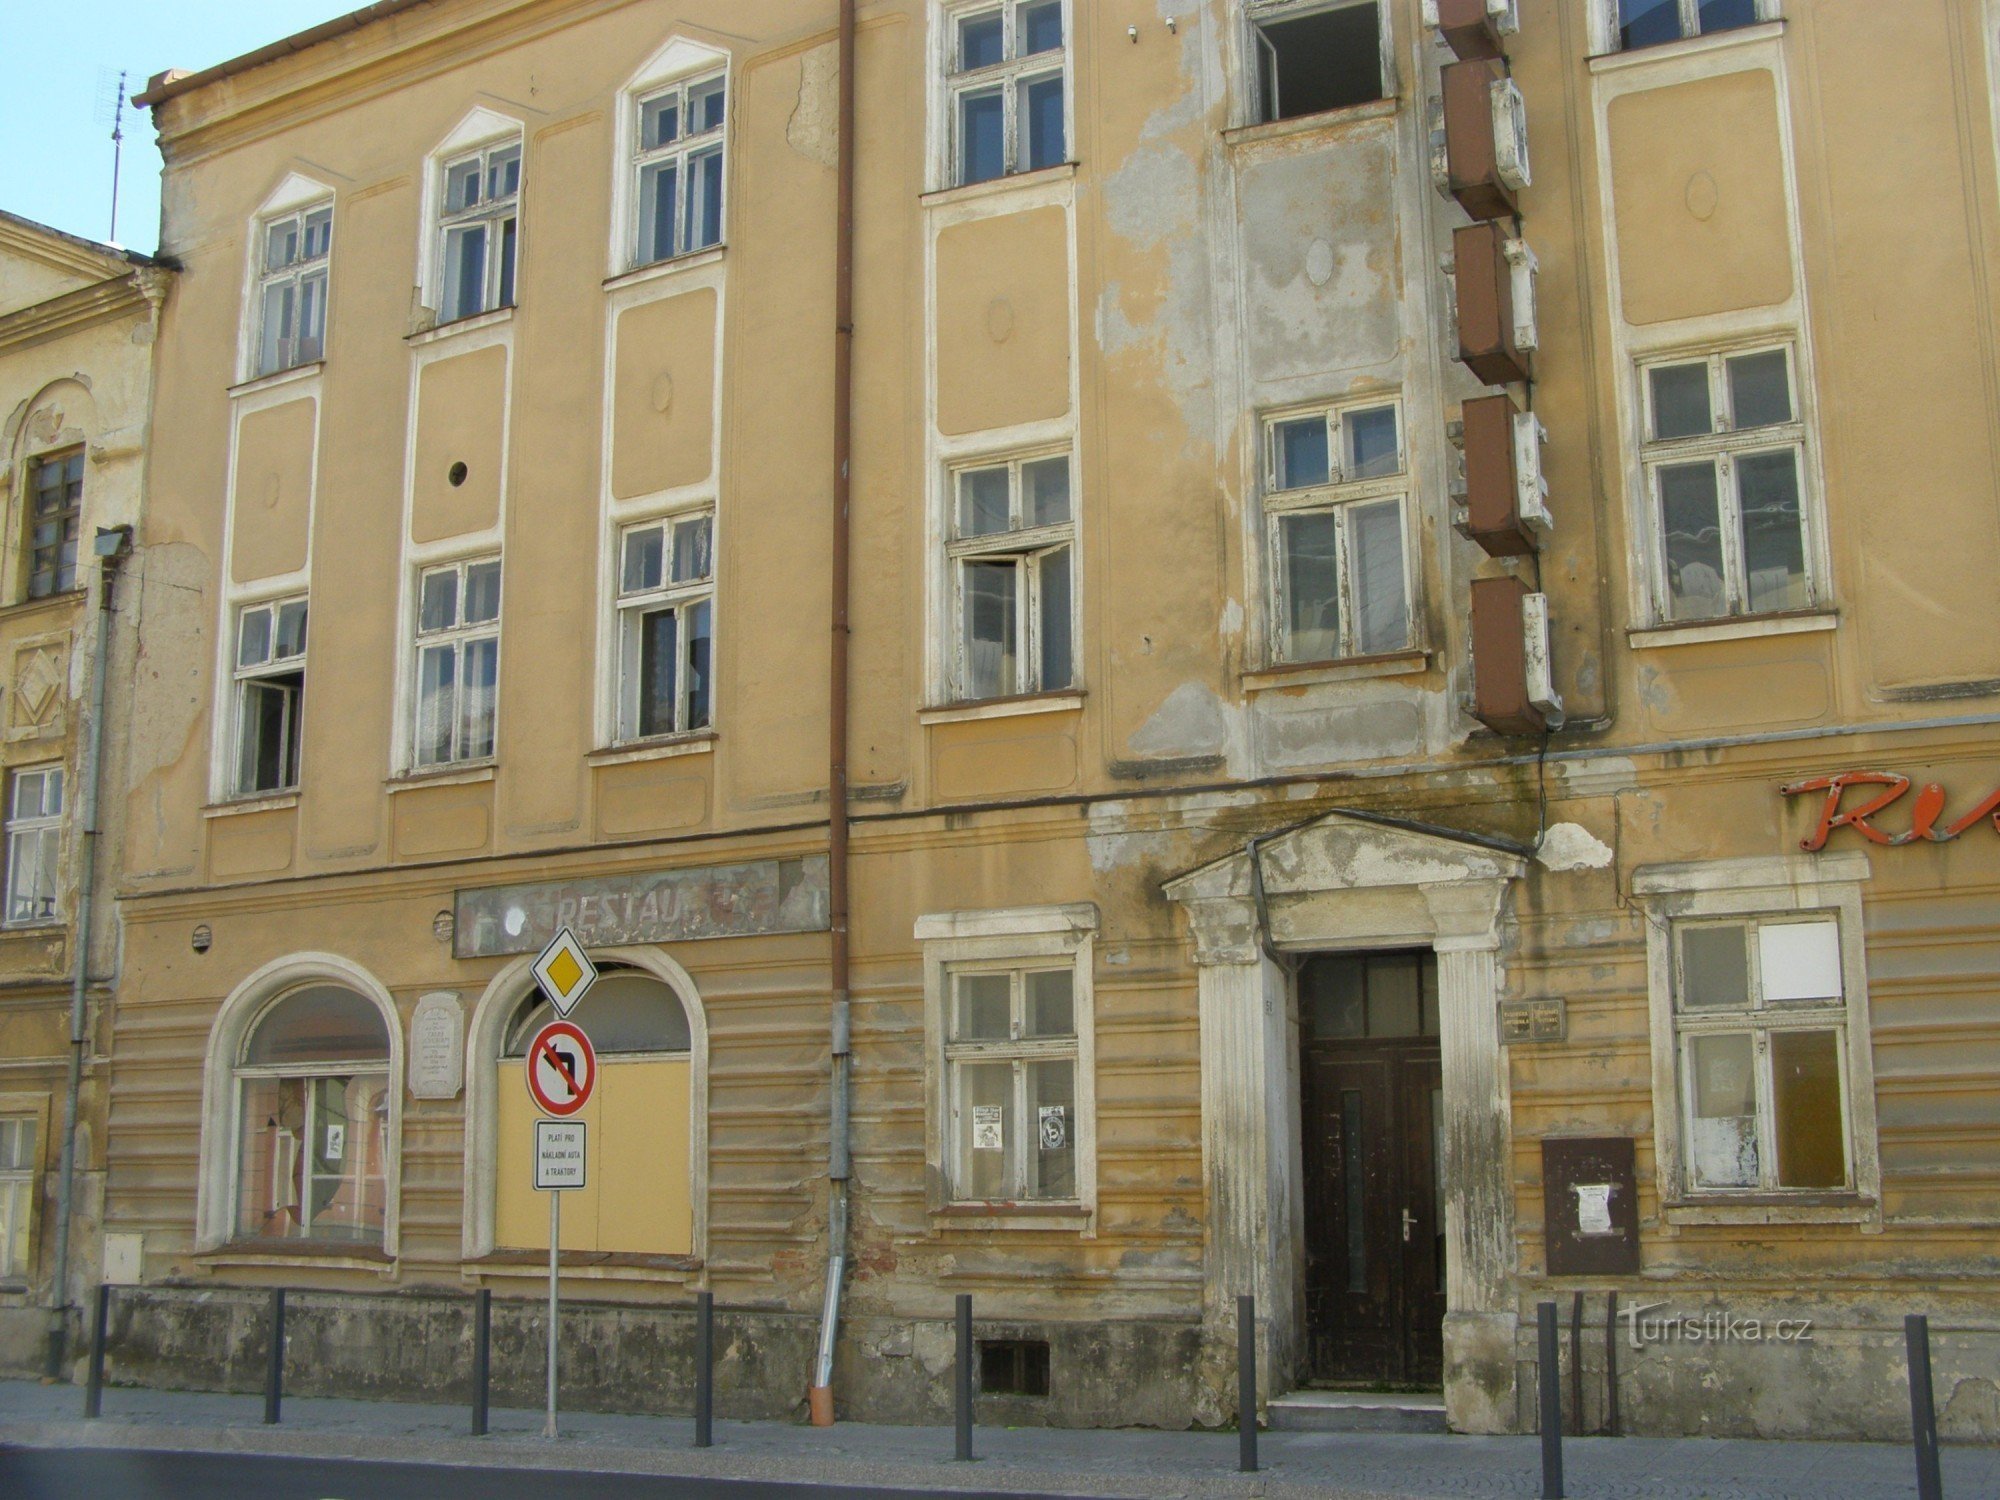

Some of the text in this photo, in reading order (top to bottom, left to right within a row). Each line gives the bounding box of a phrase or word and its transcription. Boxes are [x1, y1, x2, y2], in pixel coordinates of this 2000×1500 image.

[548, 1132, 575, 1142] PLATÍ PRO
[542, 1149, 580, 1159] NÁKLADNÍ AUTA
[551, 1167, 576, 1176] TRAKTORY
